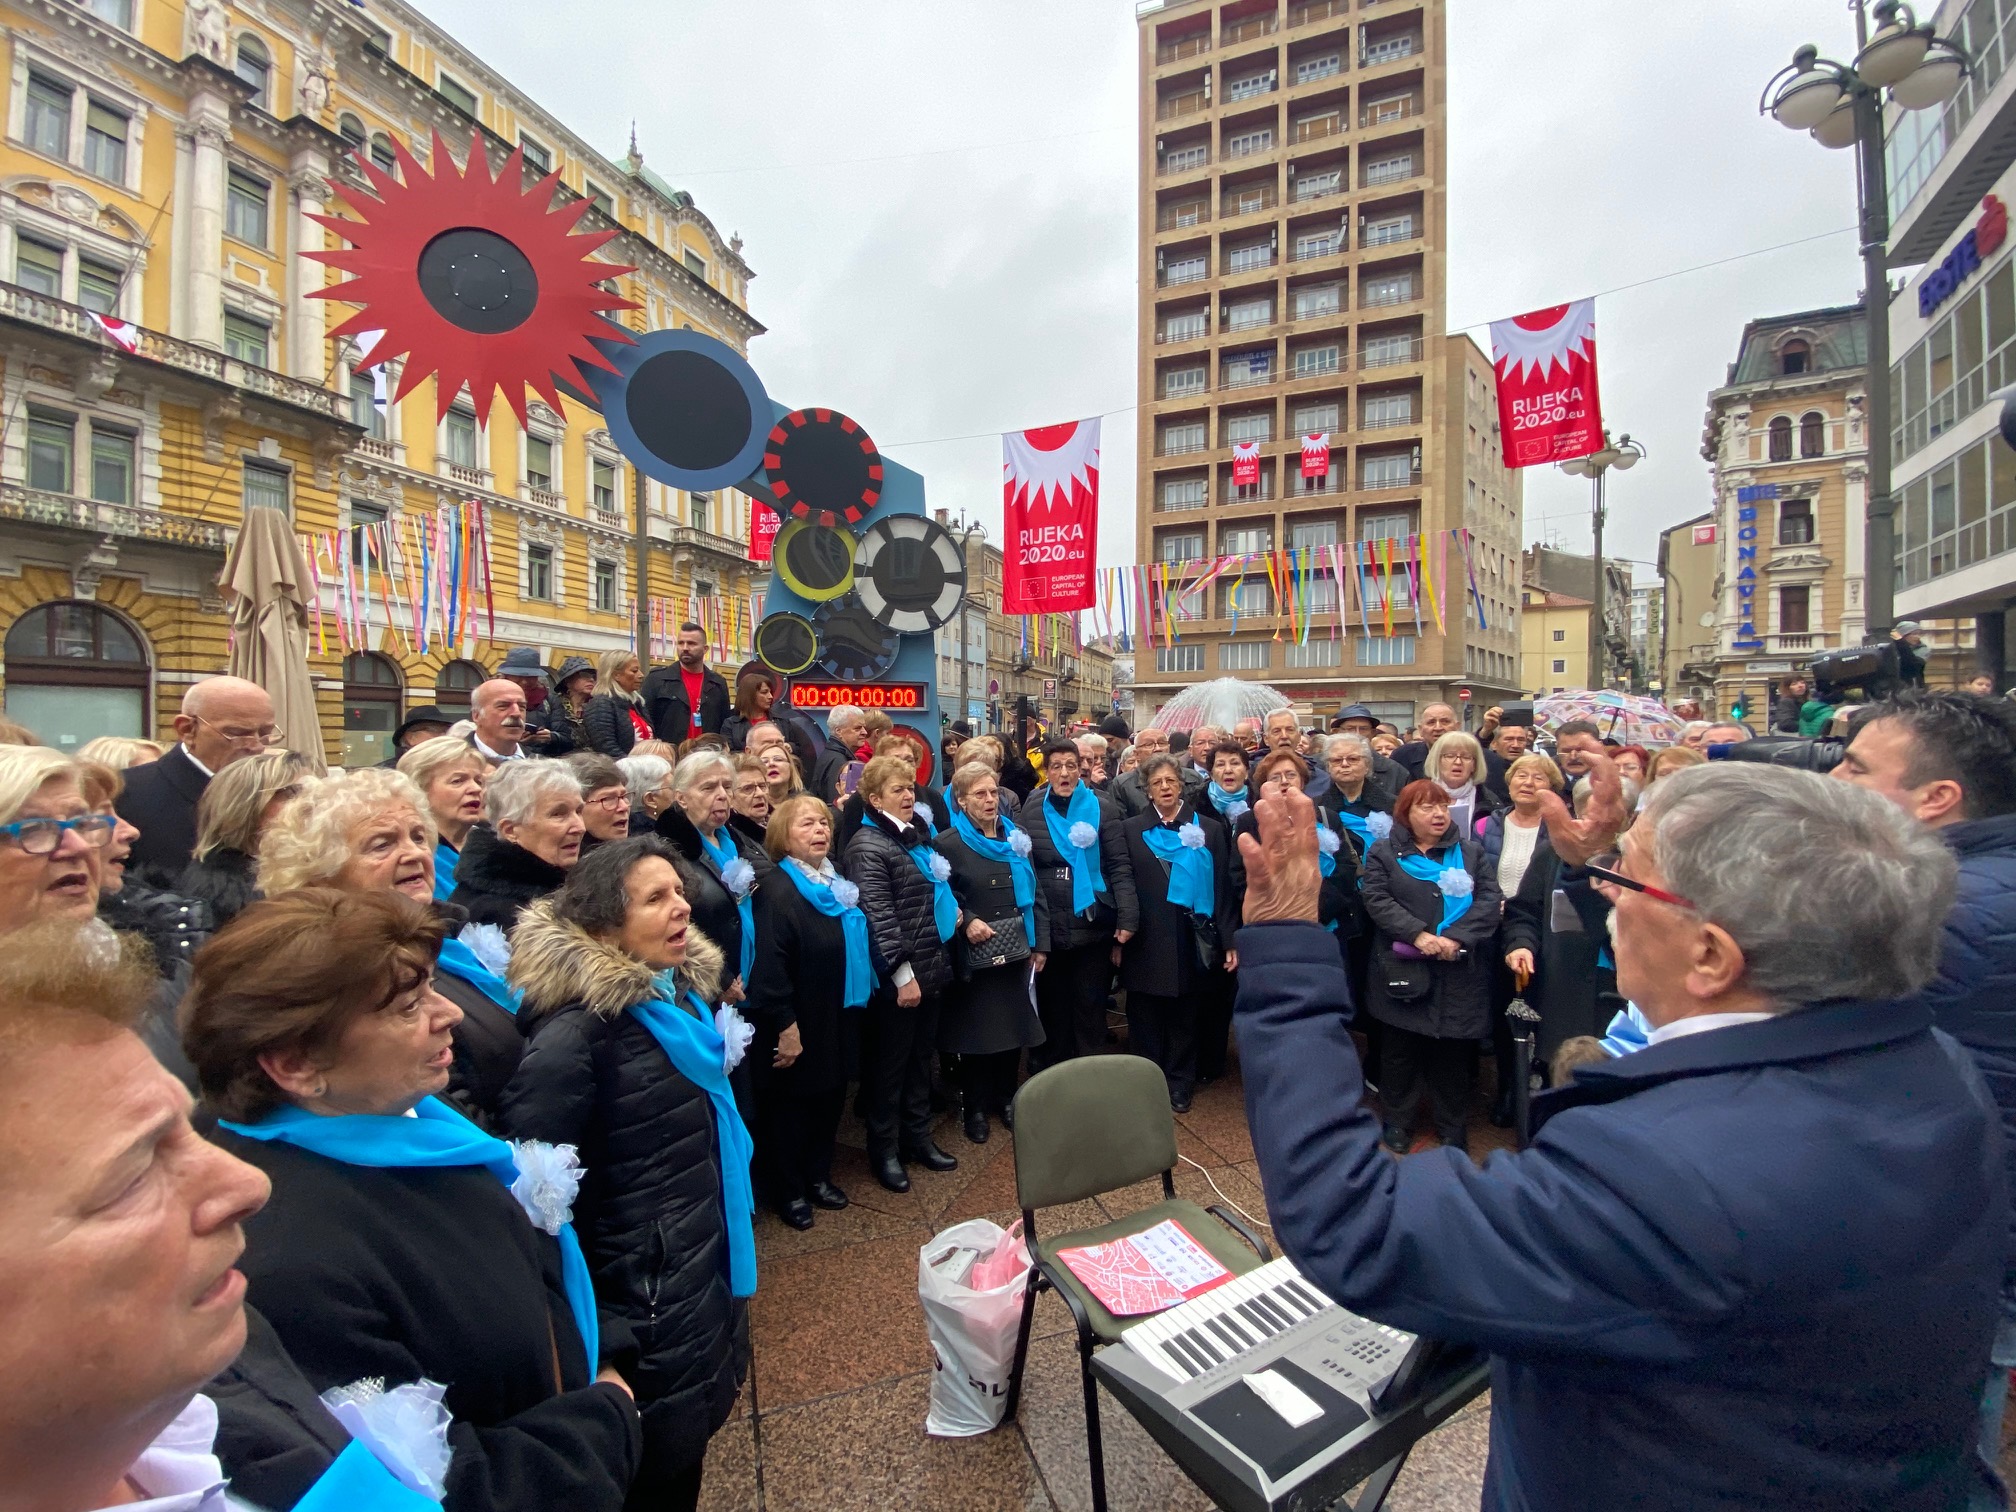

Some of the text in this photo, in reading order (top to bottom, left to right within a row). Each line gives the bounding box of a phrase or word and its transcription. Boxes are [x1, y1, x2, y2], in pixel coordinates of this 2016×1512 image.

[1512, 387, 1583, 415] RIJEKA
[1513, 406, 1585, 431] 2020.eu
[1553, 444, 1582, 453] CLTURE
[1019, 523, 1084, 547] RIJEKA
[1019, 544, 1085, 566] 2020.eu
[1052, 574, 1084, 582] EUROPEAN
[1737, 507, 1758, 636] BONAVIA
[793, 686, 917, 707] 00:00:00:00
